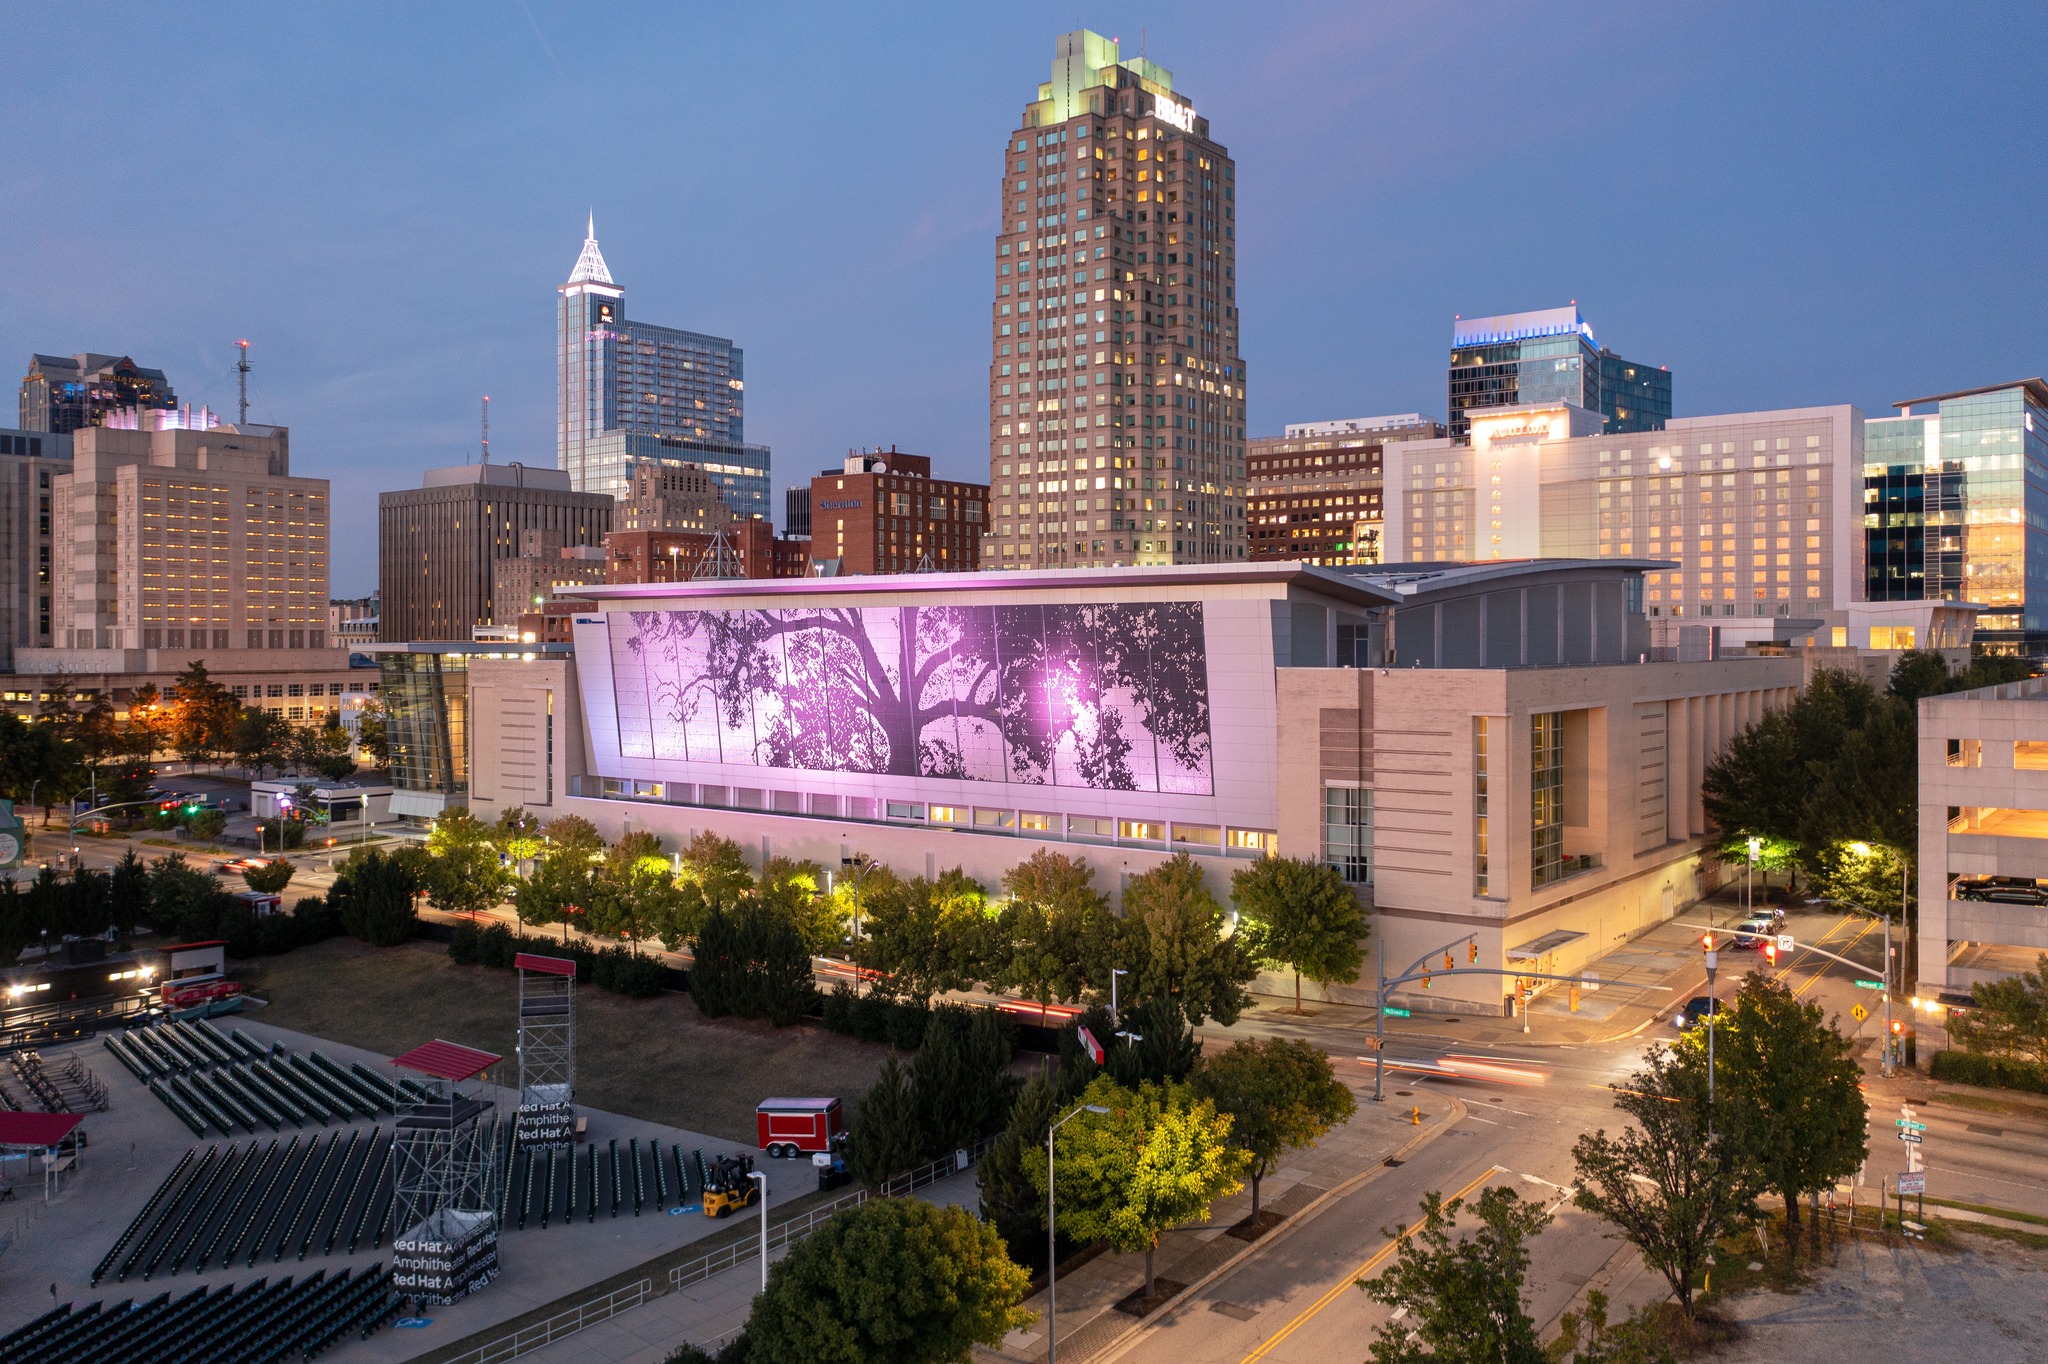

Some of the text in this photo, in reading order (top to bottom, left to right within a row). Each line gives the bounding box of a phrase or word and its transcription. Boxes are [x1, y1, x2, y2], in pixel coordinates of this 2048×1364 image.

[101, 374, 127, 382] WELLS
[820, 499, 863, 510] Sheraton
[540, 1128, 561, 1138] Hat
[466, 1238, 482, 1259] Red
[483, 1230, 497, 1247] Hat
[418, 1274, 442, 1289] Hat
[468, 1273, 489, 1294] Red
